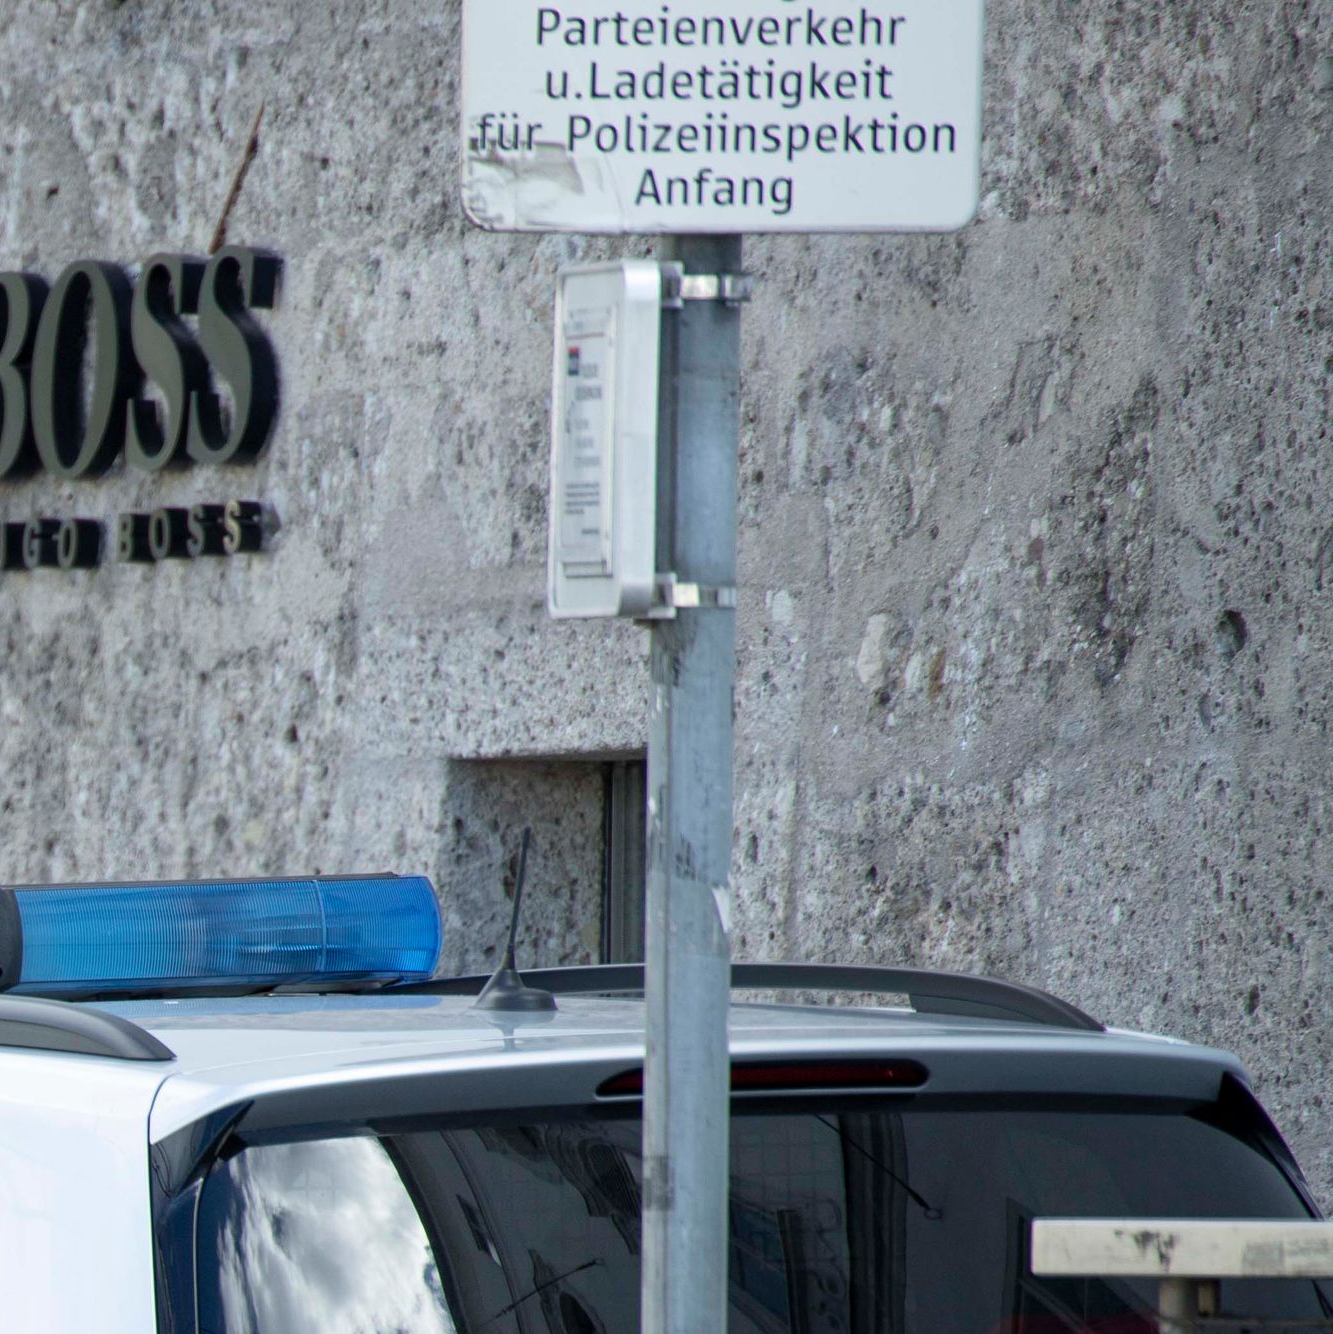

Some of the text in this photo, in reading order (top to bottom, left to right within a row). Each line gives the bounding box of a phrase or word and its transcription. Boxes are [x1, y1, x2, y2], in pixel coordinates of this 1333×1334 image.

[535, 8, 906, 47] Parteienverkehr
[545, 60, 894, 109] u.Ladetätigkeit
[476, 113, 957, 161] für Polizeiinspektion
[634, 168, 794, 216] Anfang
[117, 500, 261, 563] BOSS
